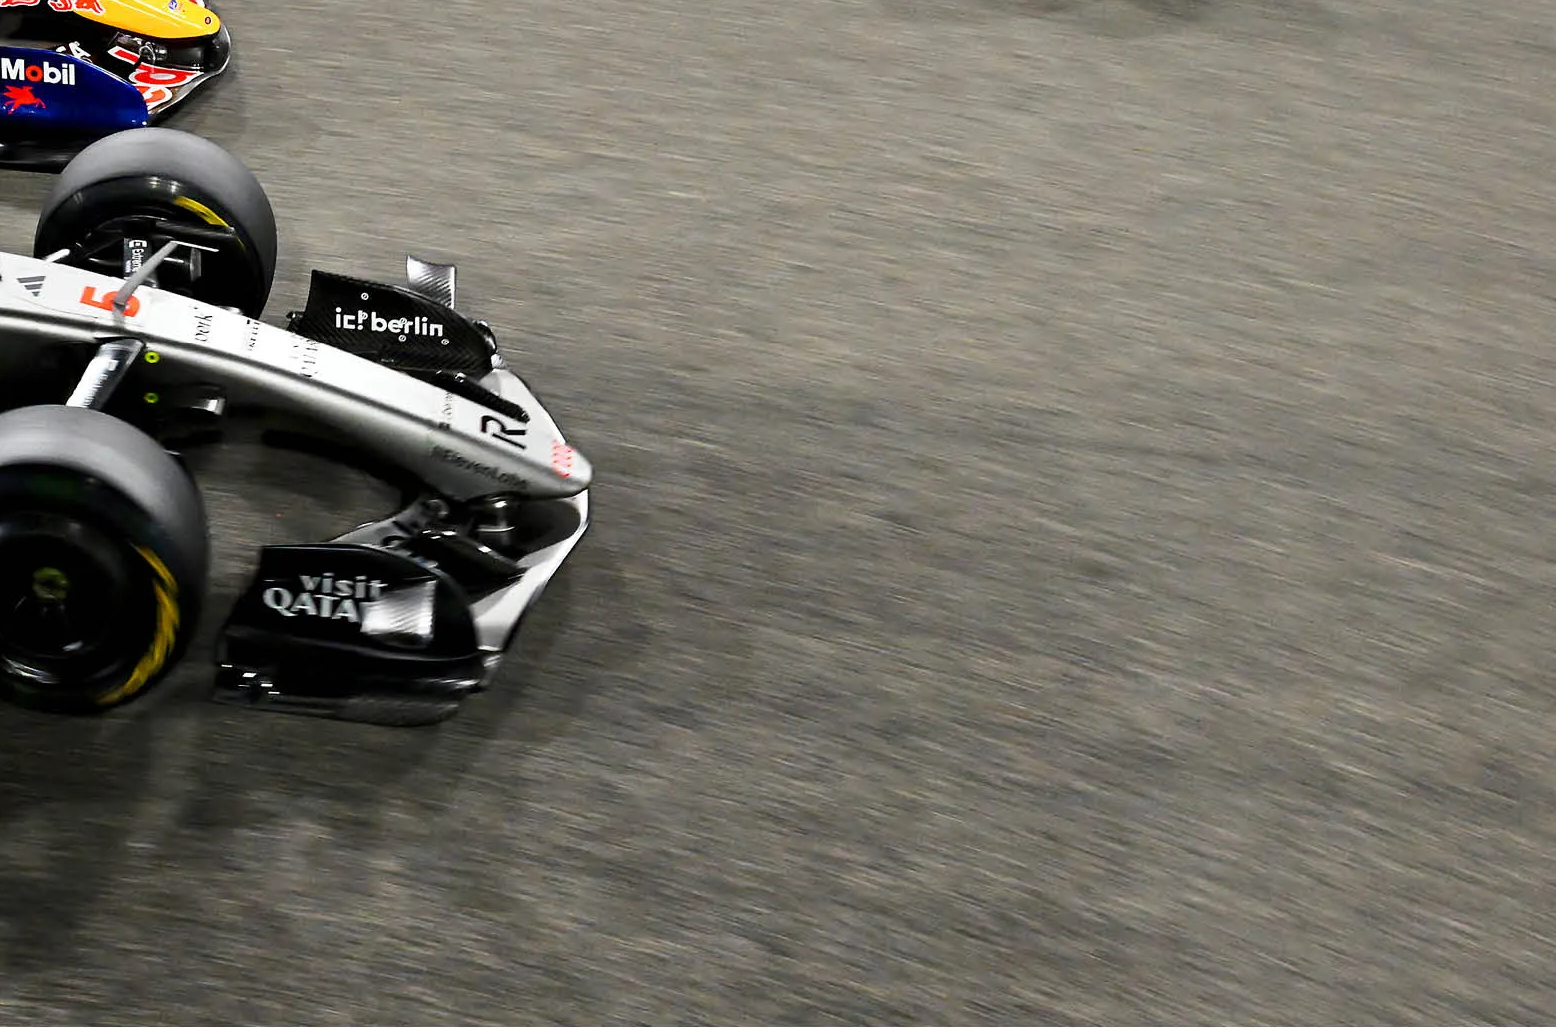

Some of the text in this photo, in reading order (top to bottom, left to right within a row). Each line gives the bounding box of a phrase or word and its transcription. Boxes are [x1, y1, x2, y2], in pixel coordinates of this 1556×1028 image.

[0, 57, 76, 86] Mobil
[371, 311, 443, 337] berlin
[299, 572, 388, 599] visit
[262, 587, 364, 624] QATA
